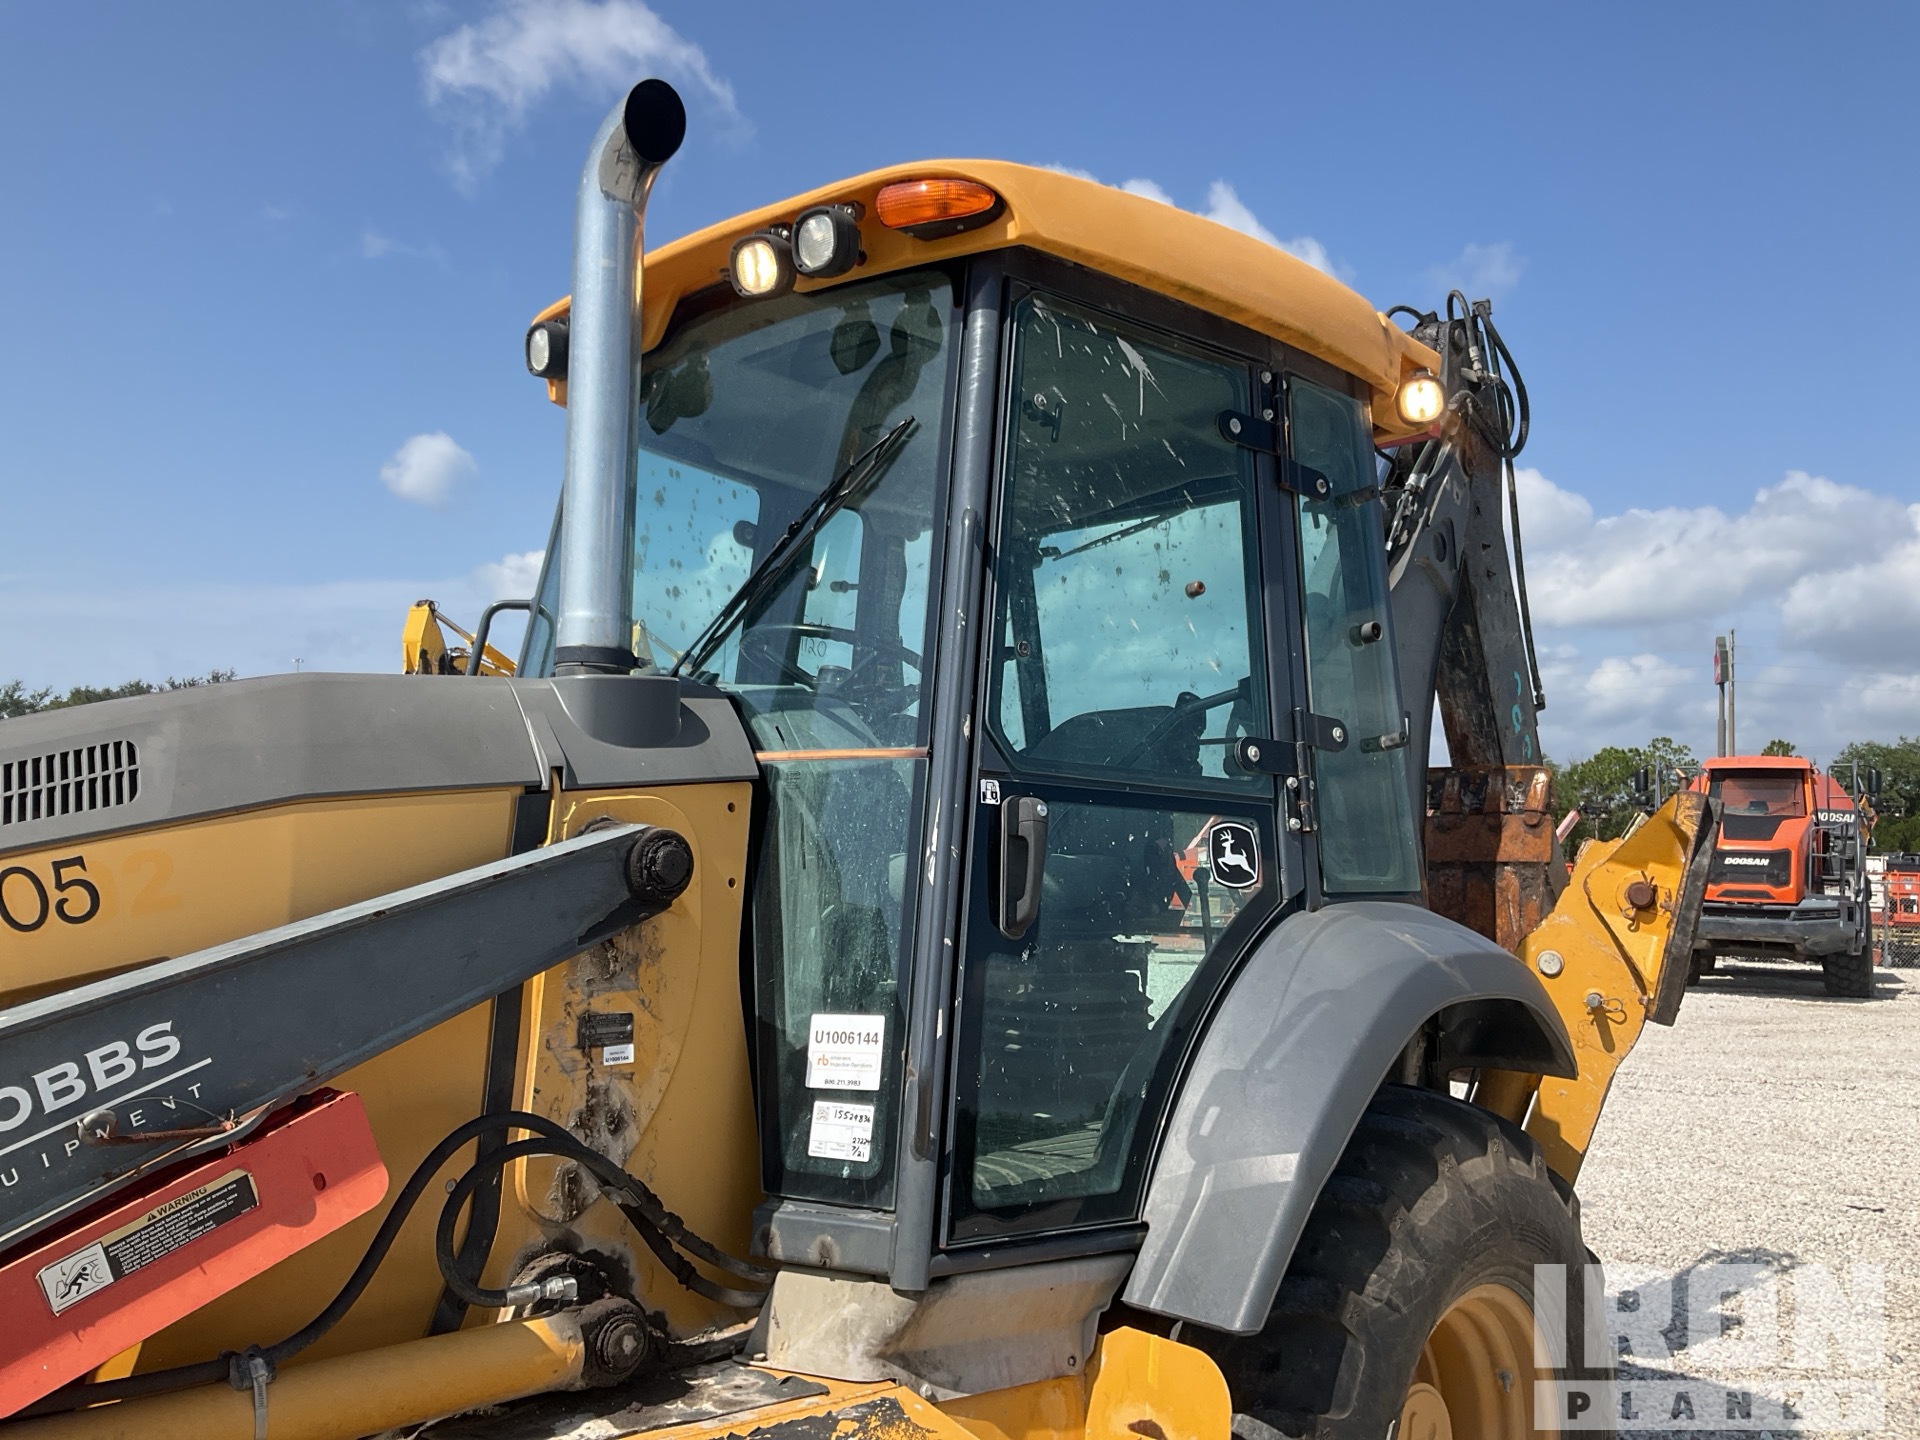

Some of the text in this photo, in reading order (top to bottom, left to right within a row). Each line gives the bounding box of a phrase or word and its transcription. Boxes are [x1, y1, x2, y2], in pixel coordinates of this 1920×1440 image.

[1724, 857, 1770, 866] DOOSAN
[815, 1030, 879, 1045] U1006144
[157, 1186, 207, 1216] WARNING
